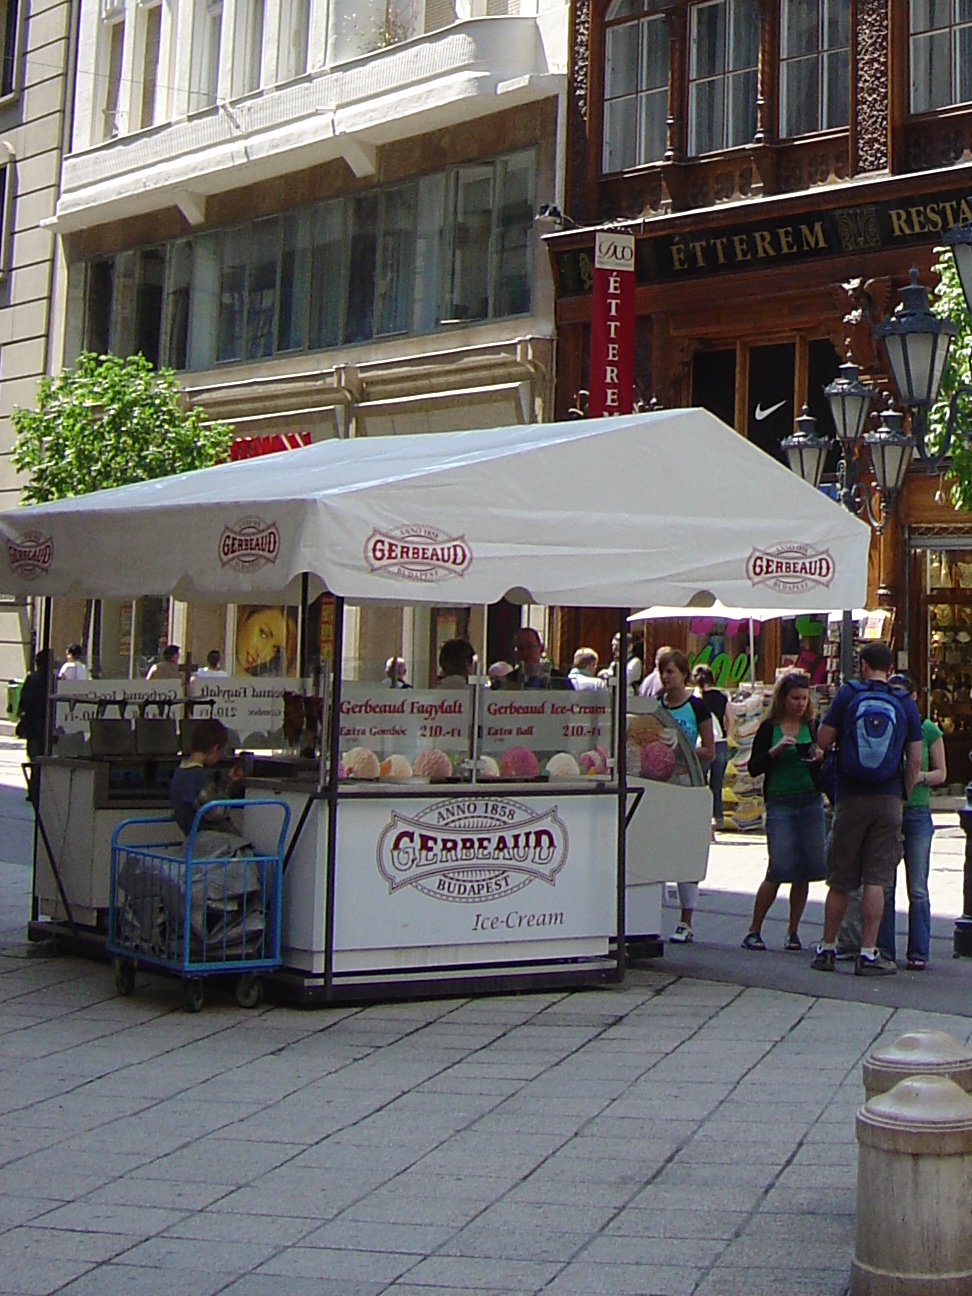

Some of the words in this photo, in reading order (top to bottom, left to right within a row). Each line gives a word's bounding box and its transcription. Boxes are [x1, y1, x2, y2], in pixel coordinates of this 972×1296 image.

[669, 221, 828, 271] ÉTTEREM
[603, 271, 621, 418] ÉTTERE
[222, 531, 277, 557] GERBEAUD
[371, 539, 468, 566] GERBEAUD
[752, 555, 831, 578] GERBEAUD
[340, 699, 407, 716] Gerbeaud
[409, 699, 463, 721] Fagylalt
[487, 701, 547, 716] Gerbeaud
[550, 703, 607, 716] Ice-Cream
[437, 802, 477, 824] ANNO
[483, 802, 516, 822] 1858
[390, 829, 557, 872] GERBEAUD
[436, 875, 512, 896] BUDAPEST
[471, 911, 565, 932] Ice-Cream
